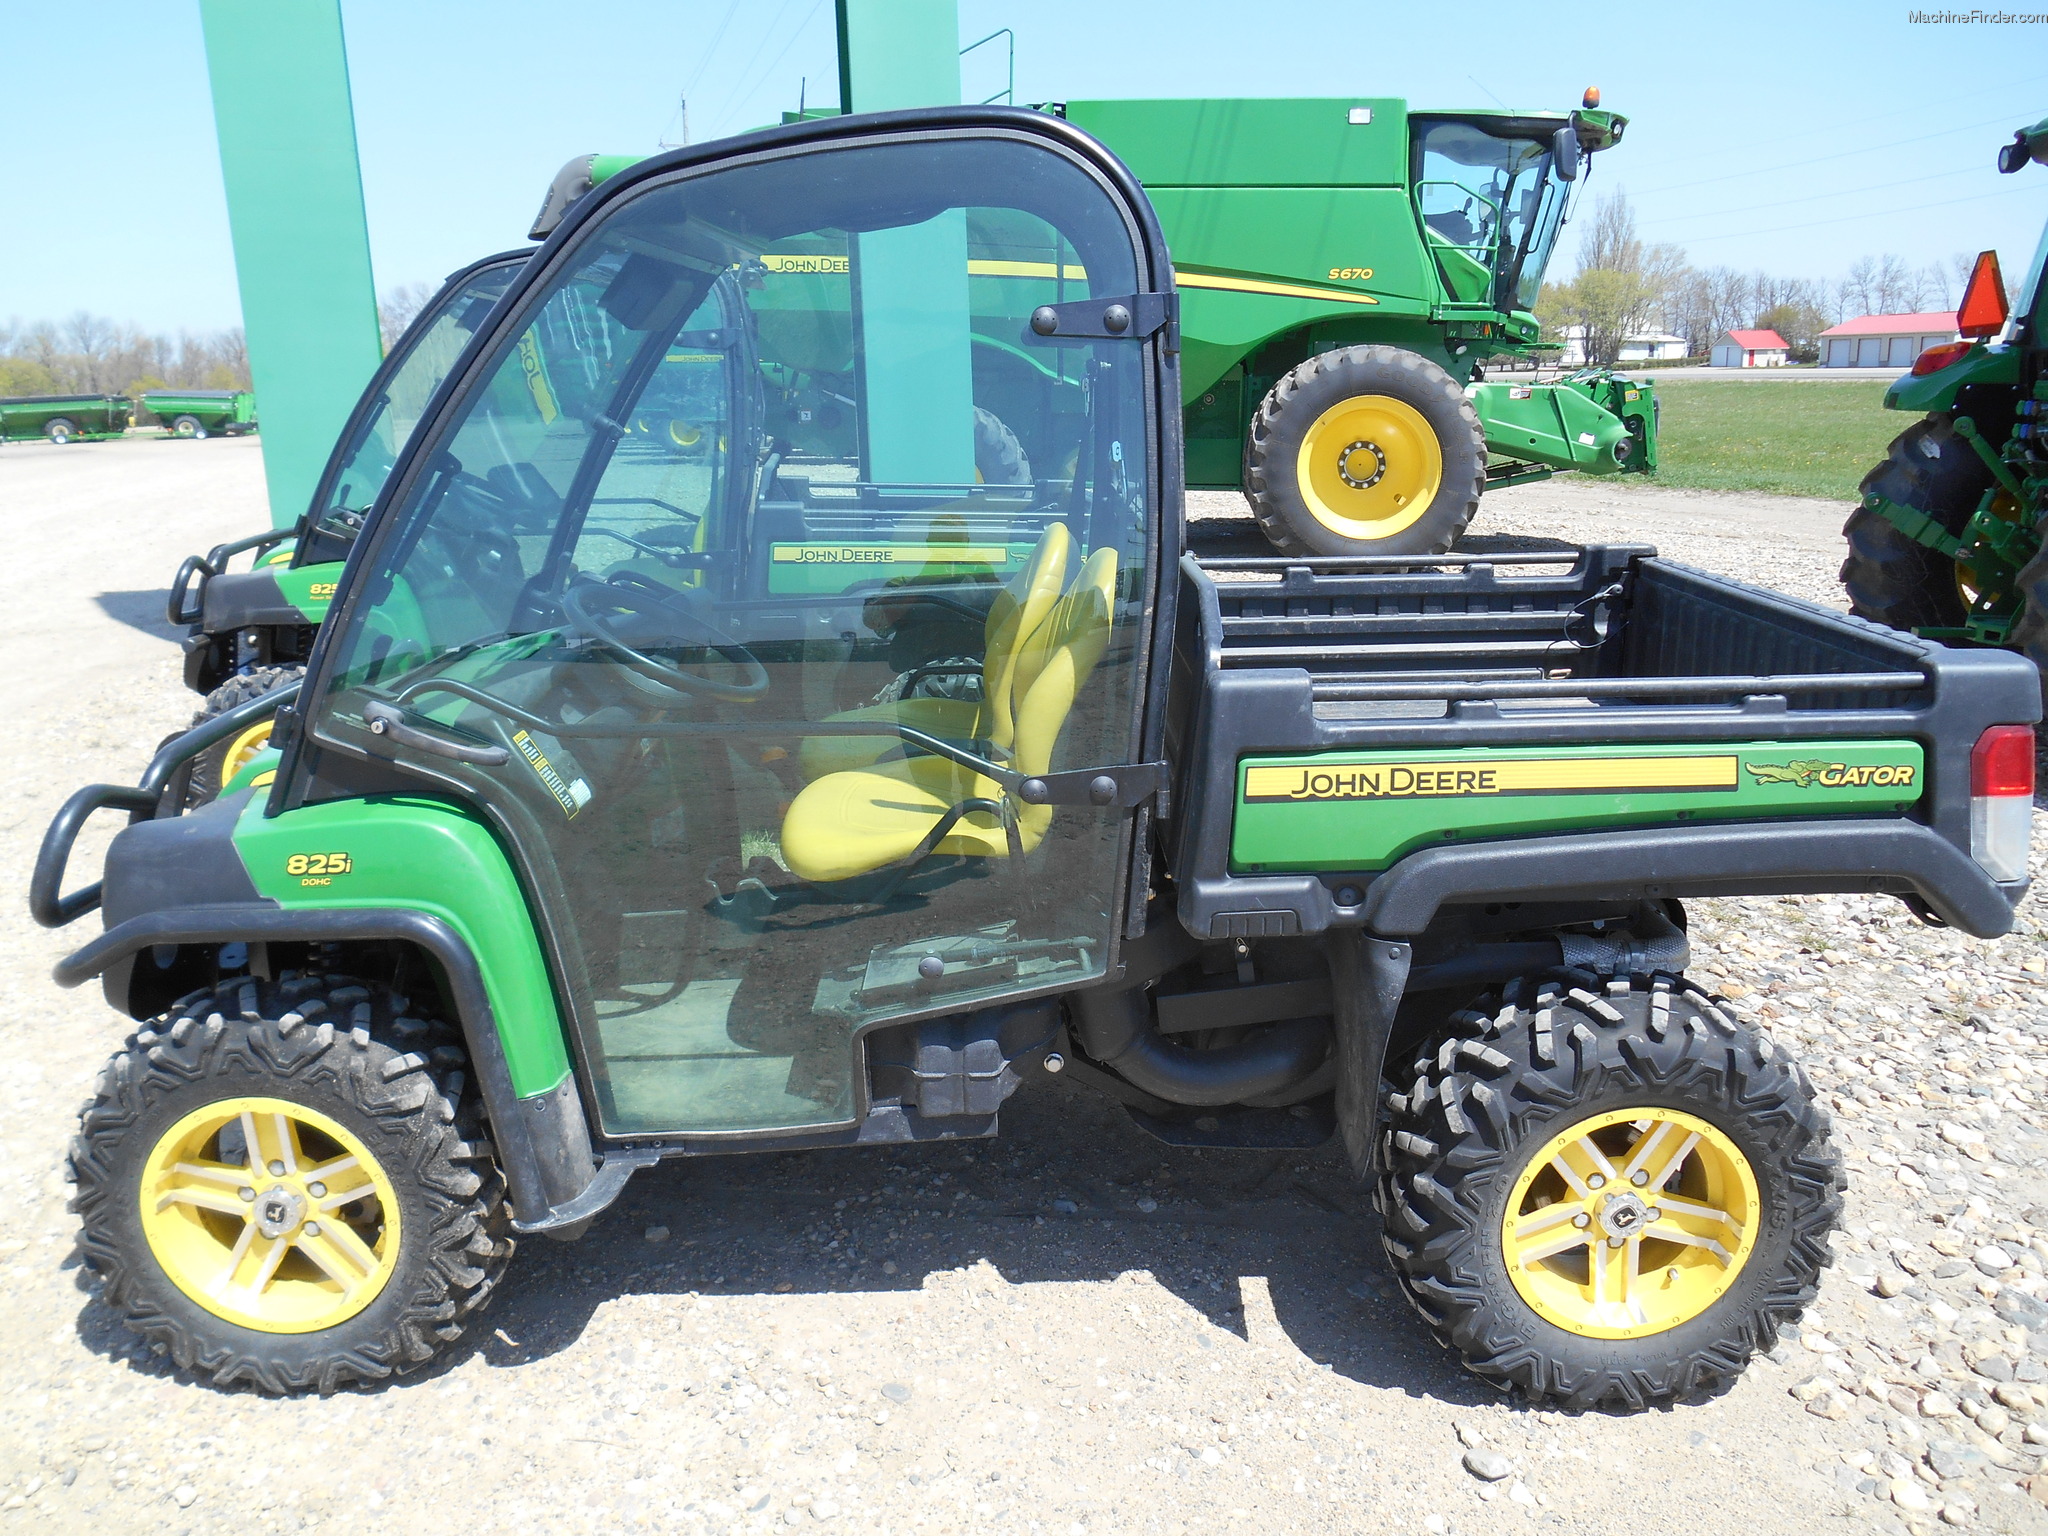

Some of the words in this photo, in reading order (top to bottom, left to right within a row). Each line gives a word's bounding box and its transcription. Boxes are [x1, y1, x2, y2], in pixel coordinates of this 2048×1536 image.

[775, 258, 817, 271] JOHN
[820, 258, 849, 271] DEE
[1328, 267, 1374, 280] S670
[795, 549, 838, 561] JOHN
[841, 549, 893, 561] DEERE
[310, 583, 339, 595] 825
[1818, 762, 1916, 787] GATOR
[1291, 770, 1381, 795] JOHN
[1390, 768, 1497, 792] DEERE
[286, 852, 353, 876] 825i
[301, 878, 332, 887] DOHC
